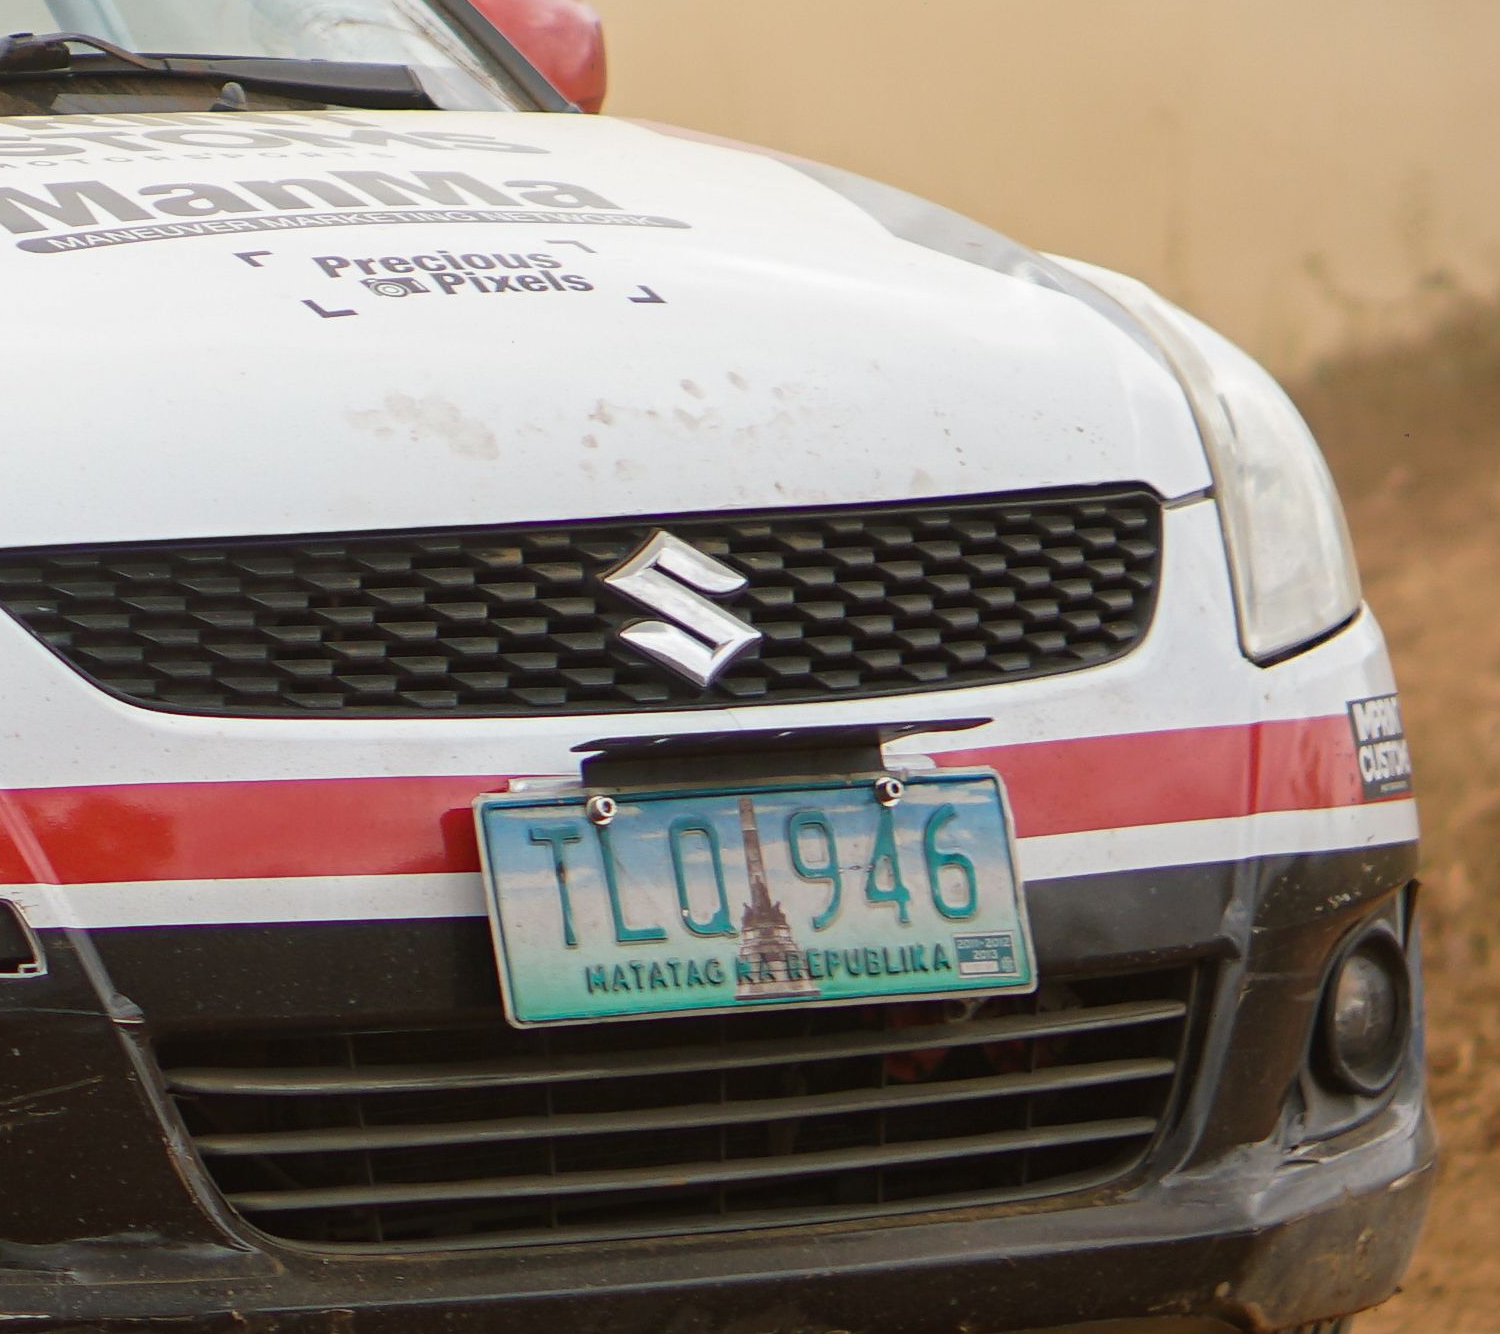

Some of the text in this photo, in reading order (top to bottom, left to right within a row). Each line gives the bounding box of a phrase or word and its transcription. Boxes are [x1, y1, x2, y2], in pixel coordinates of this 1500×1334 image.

[47, 212, 662, 250] MANEUVER MARKETING NETWORK
[312, 251, 562, 278] Precious
[437, 270, 594, 295] Pixels
[529, 803, 978, 948] TLQ 946
[585, 943, 953, 994] MATATAG NA REPUBLIKA
